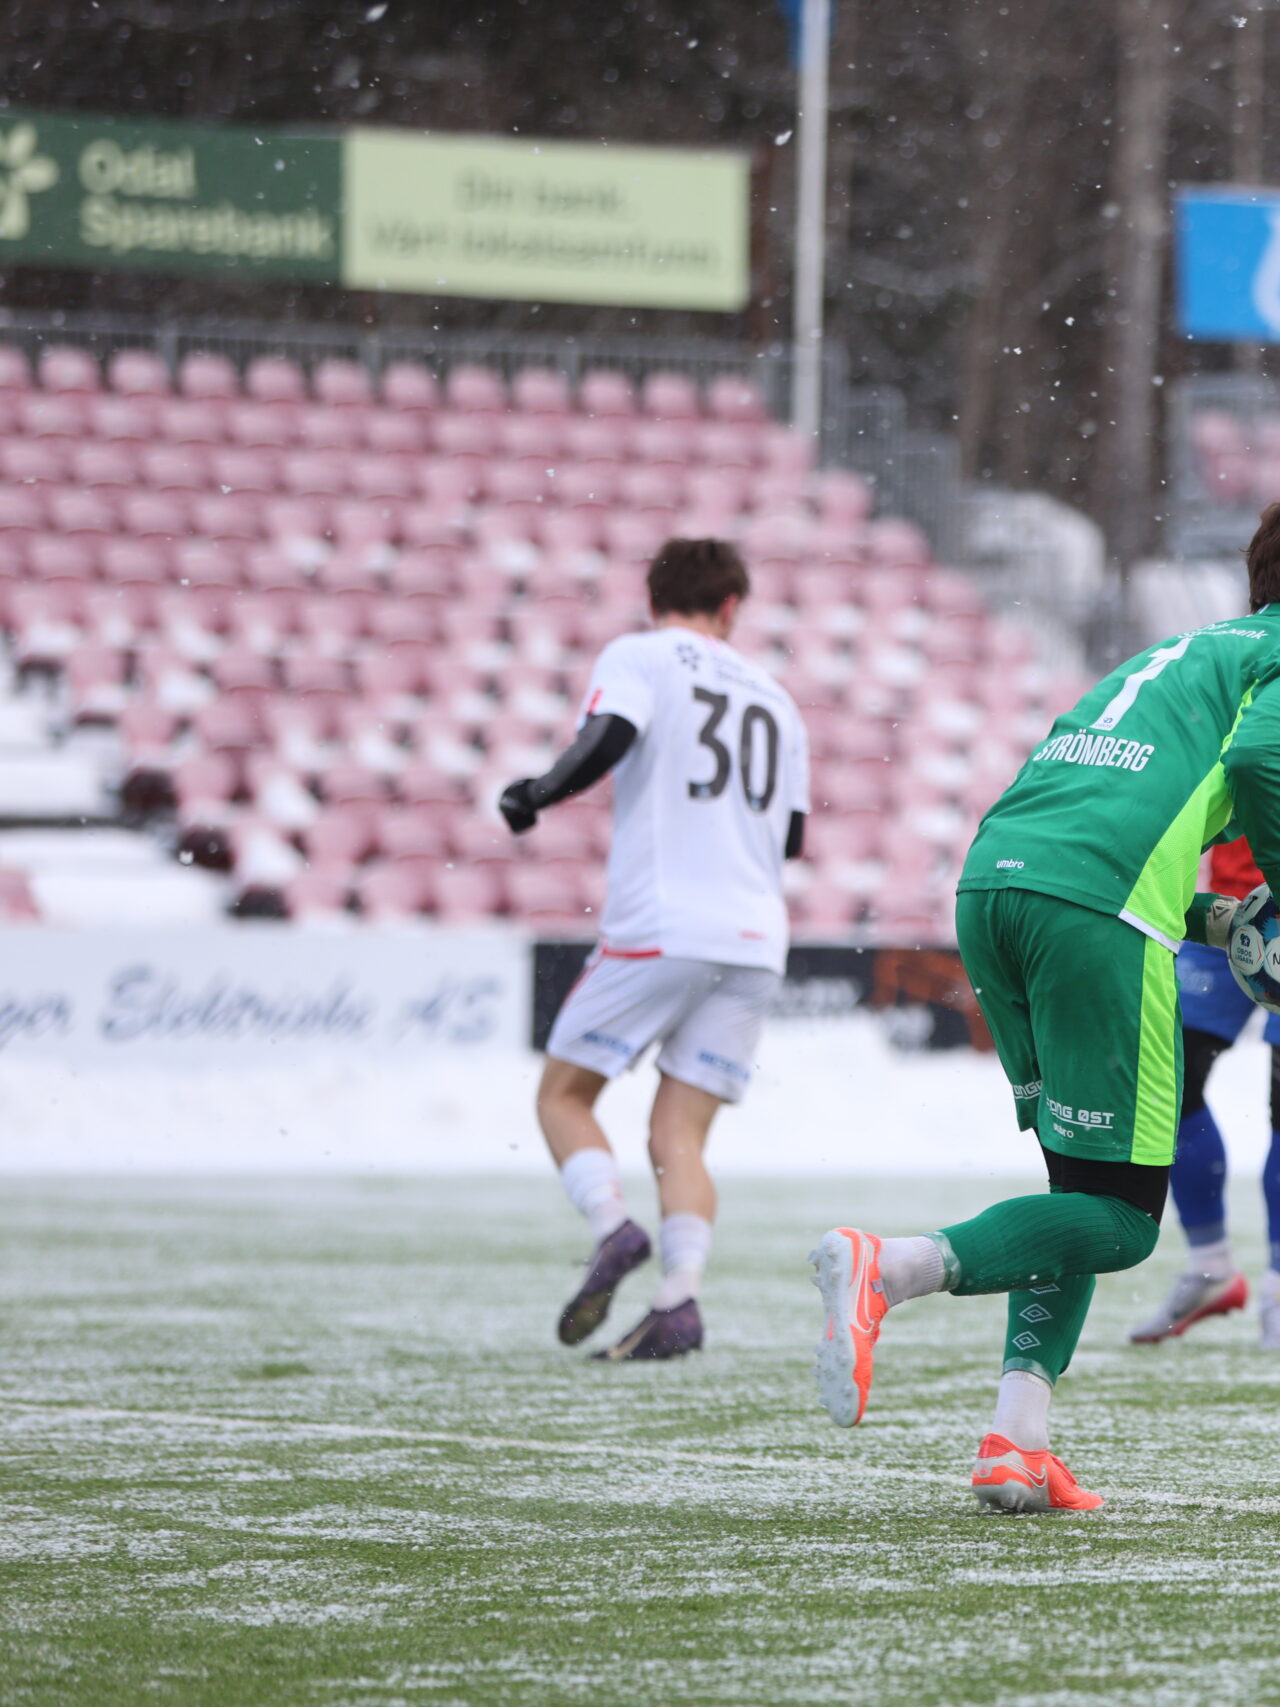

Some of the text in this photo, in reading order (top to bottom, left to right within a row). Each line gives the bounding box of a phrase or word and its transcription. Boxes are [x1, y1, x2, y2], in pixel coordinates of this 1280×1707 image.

[82, 196, 334, 260] Sparebank
[689, 684, 779, 812] 30
[1033, 728, 1155, 772] STRÖMBERG
[996, 859, 1024, 869] umbro
[1077, 1109, 1115, 1125] ØST
